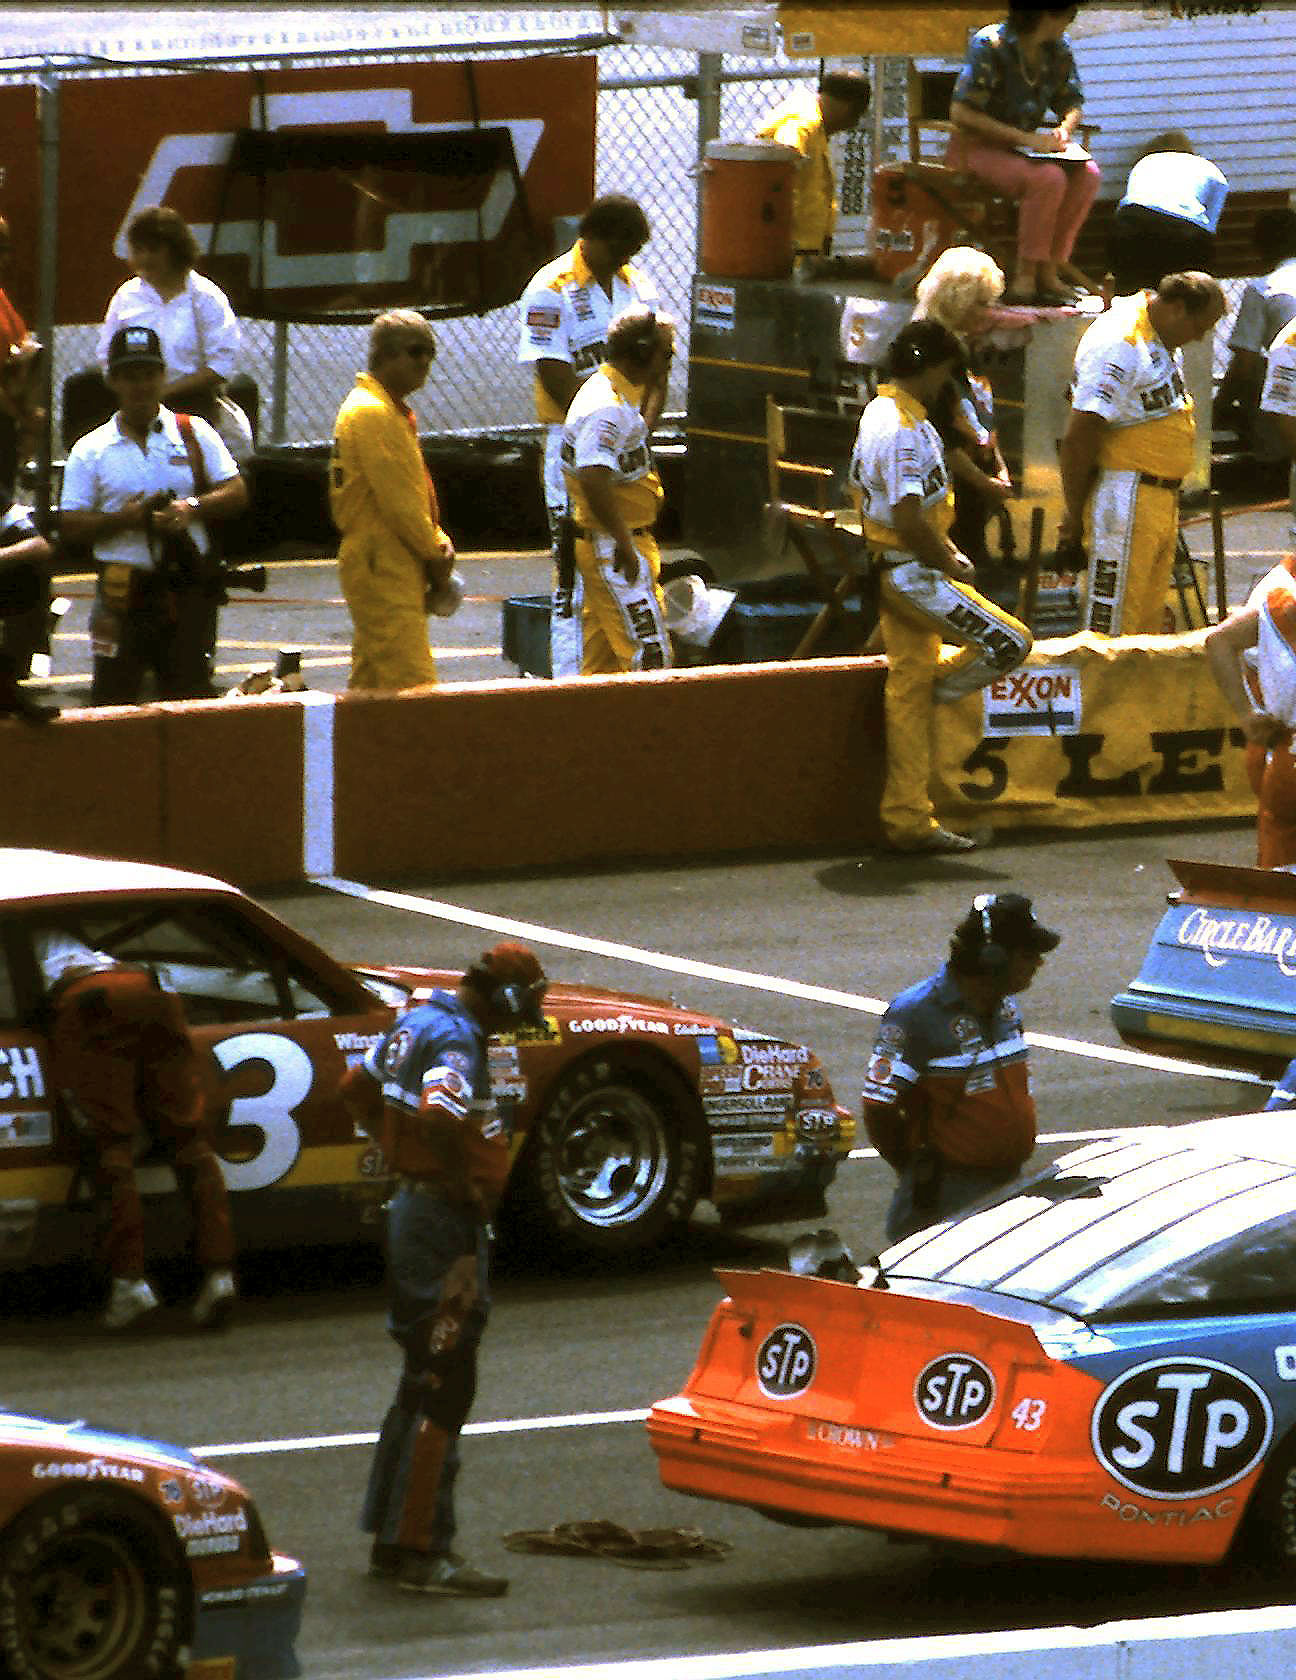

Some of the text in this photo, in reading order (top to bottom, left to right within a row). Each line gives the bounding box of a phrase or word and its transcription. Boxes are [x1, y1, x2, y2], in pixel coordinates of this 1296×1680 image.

[991, 672, 1072, 708] EXXON
[960, 727, 1246, 800] 5 LE
[1177, 908, 1250, 967] CIRCLE
[333, 1031, 387, 1050] Winst
[568, 1015, 669, 1036] GOODYEAR
[741, 1043, 810, 1065] DieHard
[214, 1032, 314, 1192] 3
[761, 1333, 810, 1385] STP
[923, 1364, 985, 1418] STP
[1011, 1397, 1046, 1431] 43
[1112, 1372, 1250, 1472] STP
[32, 1458, 145, 1483] GOODYEAR
[174, 1508, 248, 1538] DieHard
[1101, 1493, 1235, 1527] PONTIAC
